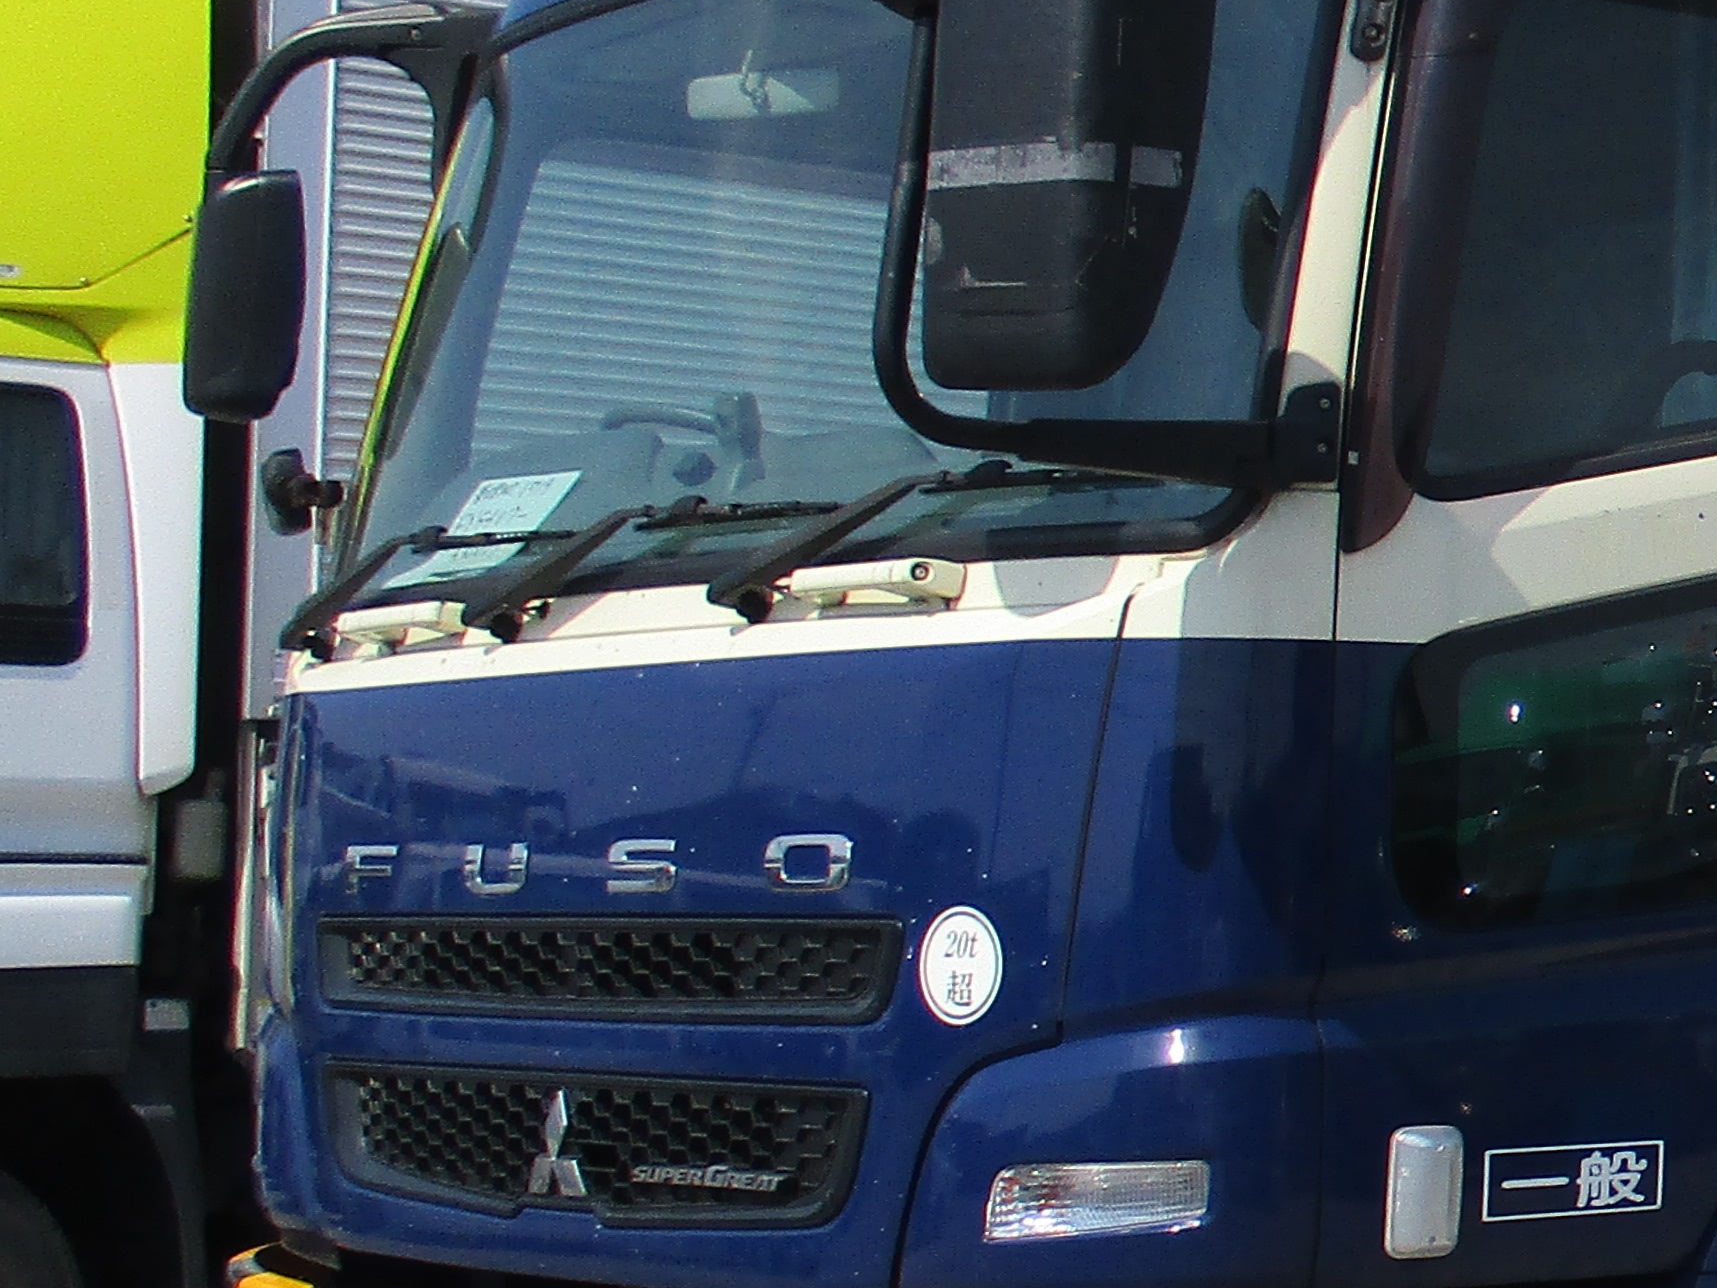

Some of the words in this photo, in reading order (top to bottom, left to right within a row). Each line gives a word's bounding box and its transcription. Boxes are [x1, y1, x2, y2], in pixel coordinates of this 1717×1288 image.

[347, 834, 852, 894] FUSO
[944, 930, 979, 959] 20t
[945, 970, 974, 1007] 超
[1501, 1150, 1649, 1208] 一般
